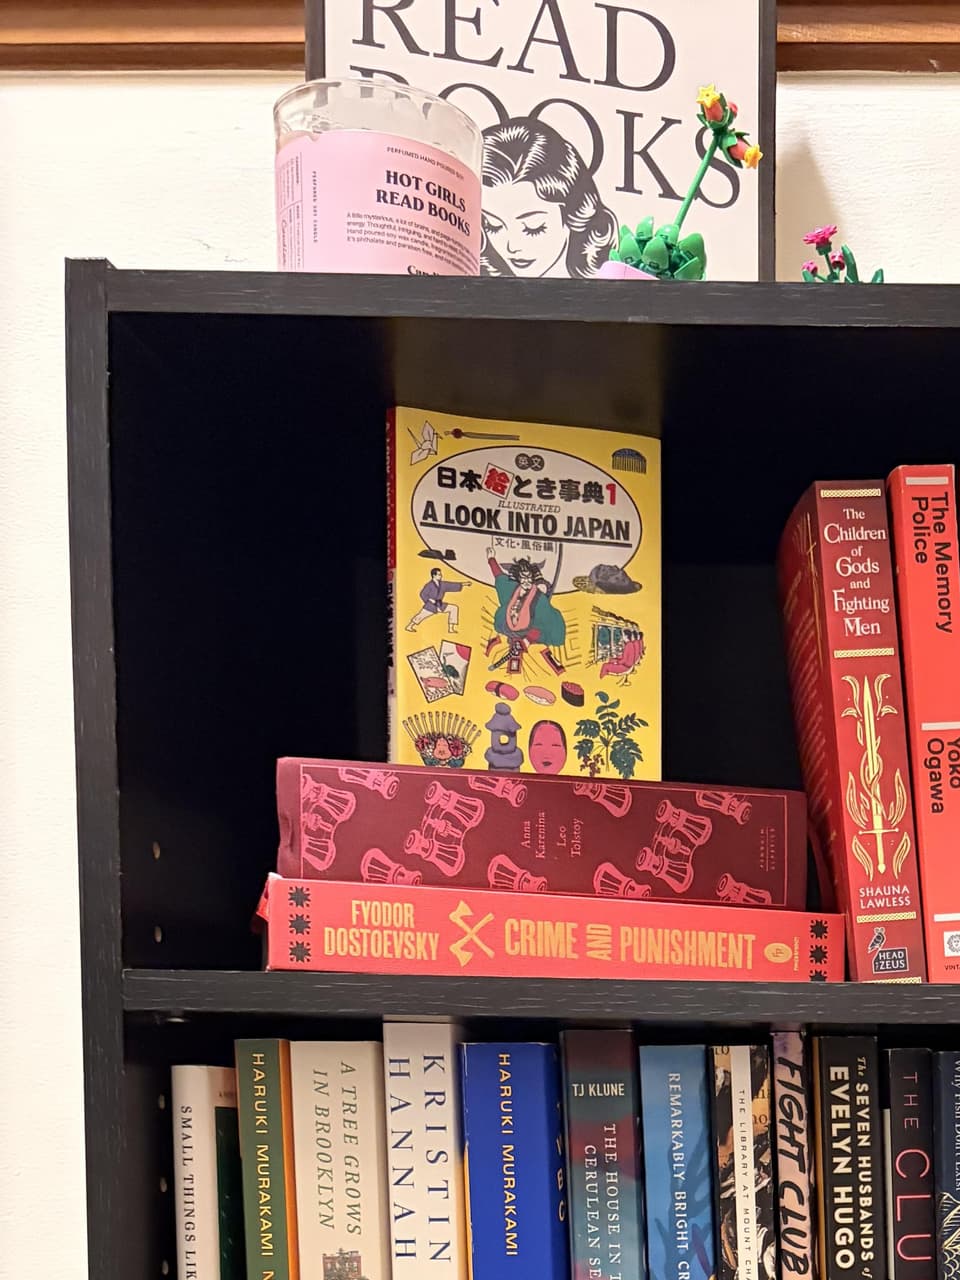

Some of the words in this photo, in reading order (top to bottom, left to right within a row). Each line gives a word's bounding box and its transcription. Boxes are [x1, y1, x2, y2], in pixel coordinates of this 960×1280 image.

[353, 0, 676, 91] READ
[376, 189, 424, 211] READ
[428, 202, 471, 236] BOOKS
[386, 170, 422, 190] HOT
[426, 181, 466, 213] GIRLS
[437, 466, 617, 505] 日本絵とき事典1
[498, 500, 561, 514] ILLUSTRATED
[422, 500, 438, 522] A
[444, 504, 500, 529] LOOK
[508, 512, 557, 536] INTO
[563, 516, 630, 541] JAPAN
[823, 523, 887, 544] Children
[911, 496, 930, 564] Police
[931, 492, 949, 534] The
[836, 557, 880, 577] Gods
[934, 542, 953, 633] Memory
[832, 589, 890, 614] Fighting
[844, 618, 881, 636] Men
[923, 738, 945, 813] Ogawa
[535, 811, 546, 860] Karenina
[570, 817, 584, 858] Tolstoy
[859, 885, 910, 898] SHAUNA
[860, 896, 911, 909] LAWLESS
[351, 900, 415, 929] FYODOR
[324, 927, 440, 961] DOSTOEVSKY
[504, 917, 578, 960] CRIME
[585, 923, 612, 961] AND
[620, 925, 756, 970] PUNISHMENT
[879, 951, 904, 961] HEAD
[879, 960, 905, 970] ZEUS
[572, 1083, 584, 1096] TJ
[588, 1083, 625, 1096] KLUNE
[180, 1105, 193, 1167] SMALL
[667, 1073, 685, 1181] REMARKABLY
[777, 1057, 805, 1174] FIGHT
[829, 1066, 852, 1174] EVELYN
[389, 1058, 417, 1259] HANNAH
[423, 1055, 451, 1262] KRISTIN
[183, 1174, 196, 1242] THINGS
[674, 1191, 688, 1251] BRIGHT
[779, 1181, 809, 1276] CLUB
[833, 1186, 855, 1269] HUGO
